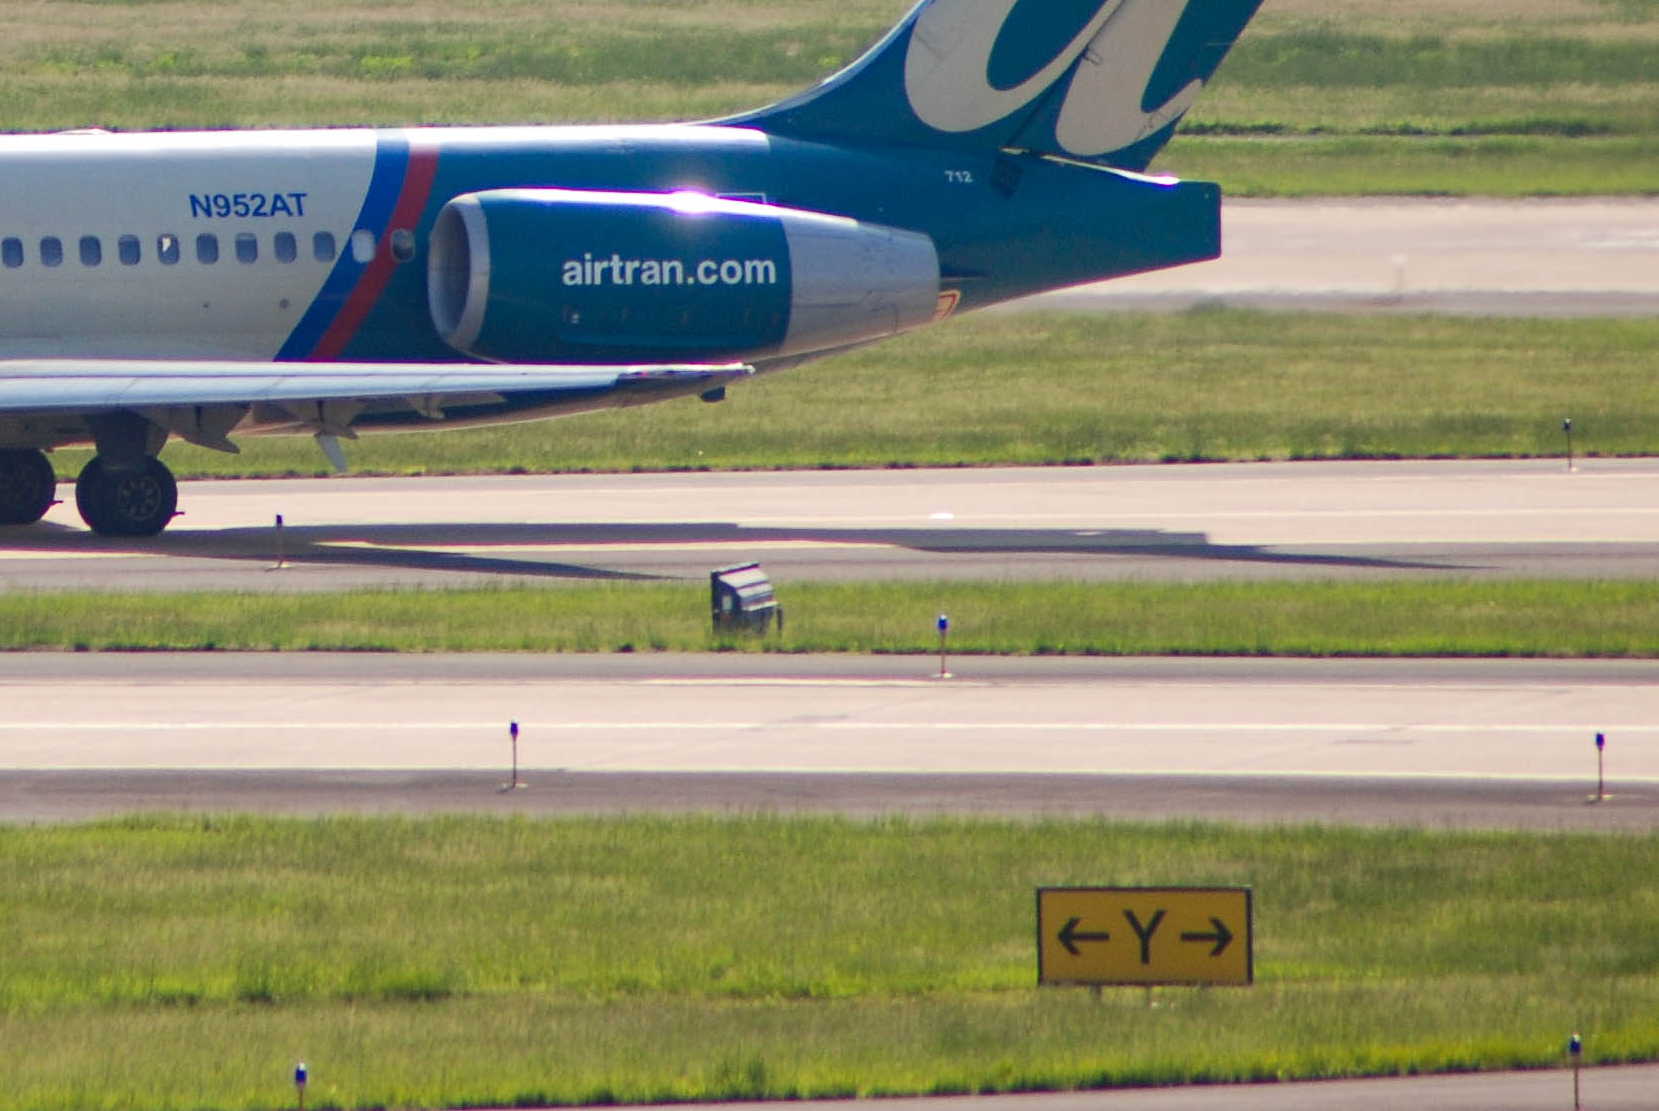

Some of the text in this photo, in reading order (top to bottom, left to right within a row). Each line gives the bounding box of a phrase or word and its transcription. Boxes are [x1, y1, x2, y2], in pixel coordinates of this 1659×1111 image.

[943, 169, 973, 183] 712
[189, 193, 308, 217] N952AT
[562, 253, 776, 285] airtran.com
[1124, 909, 1166, 964] Y
